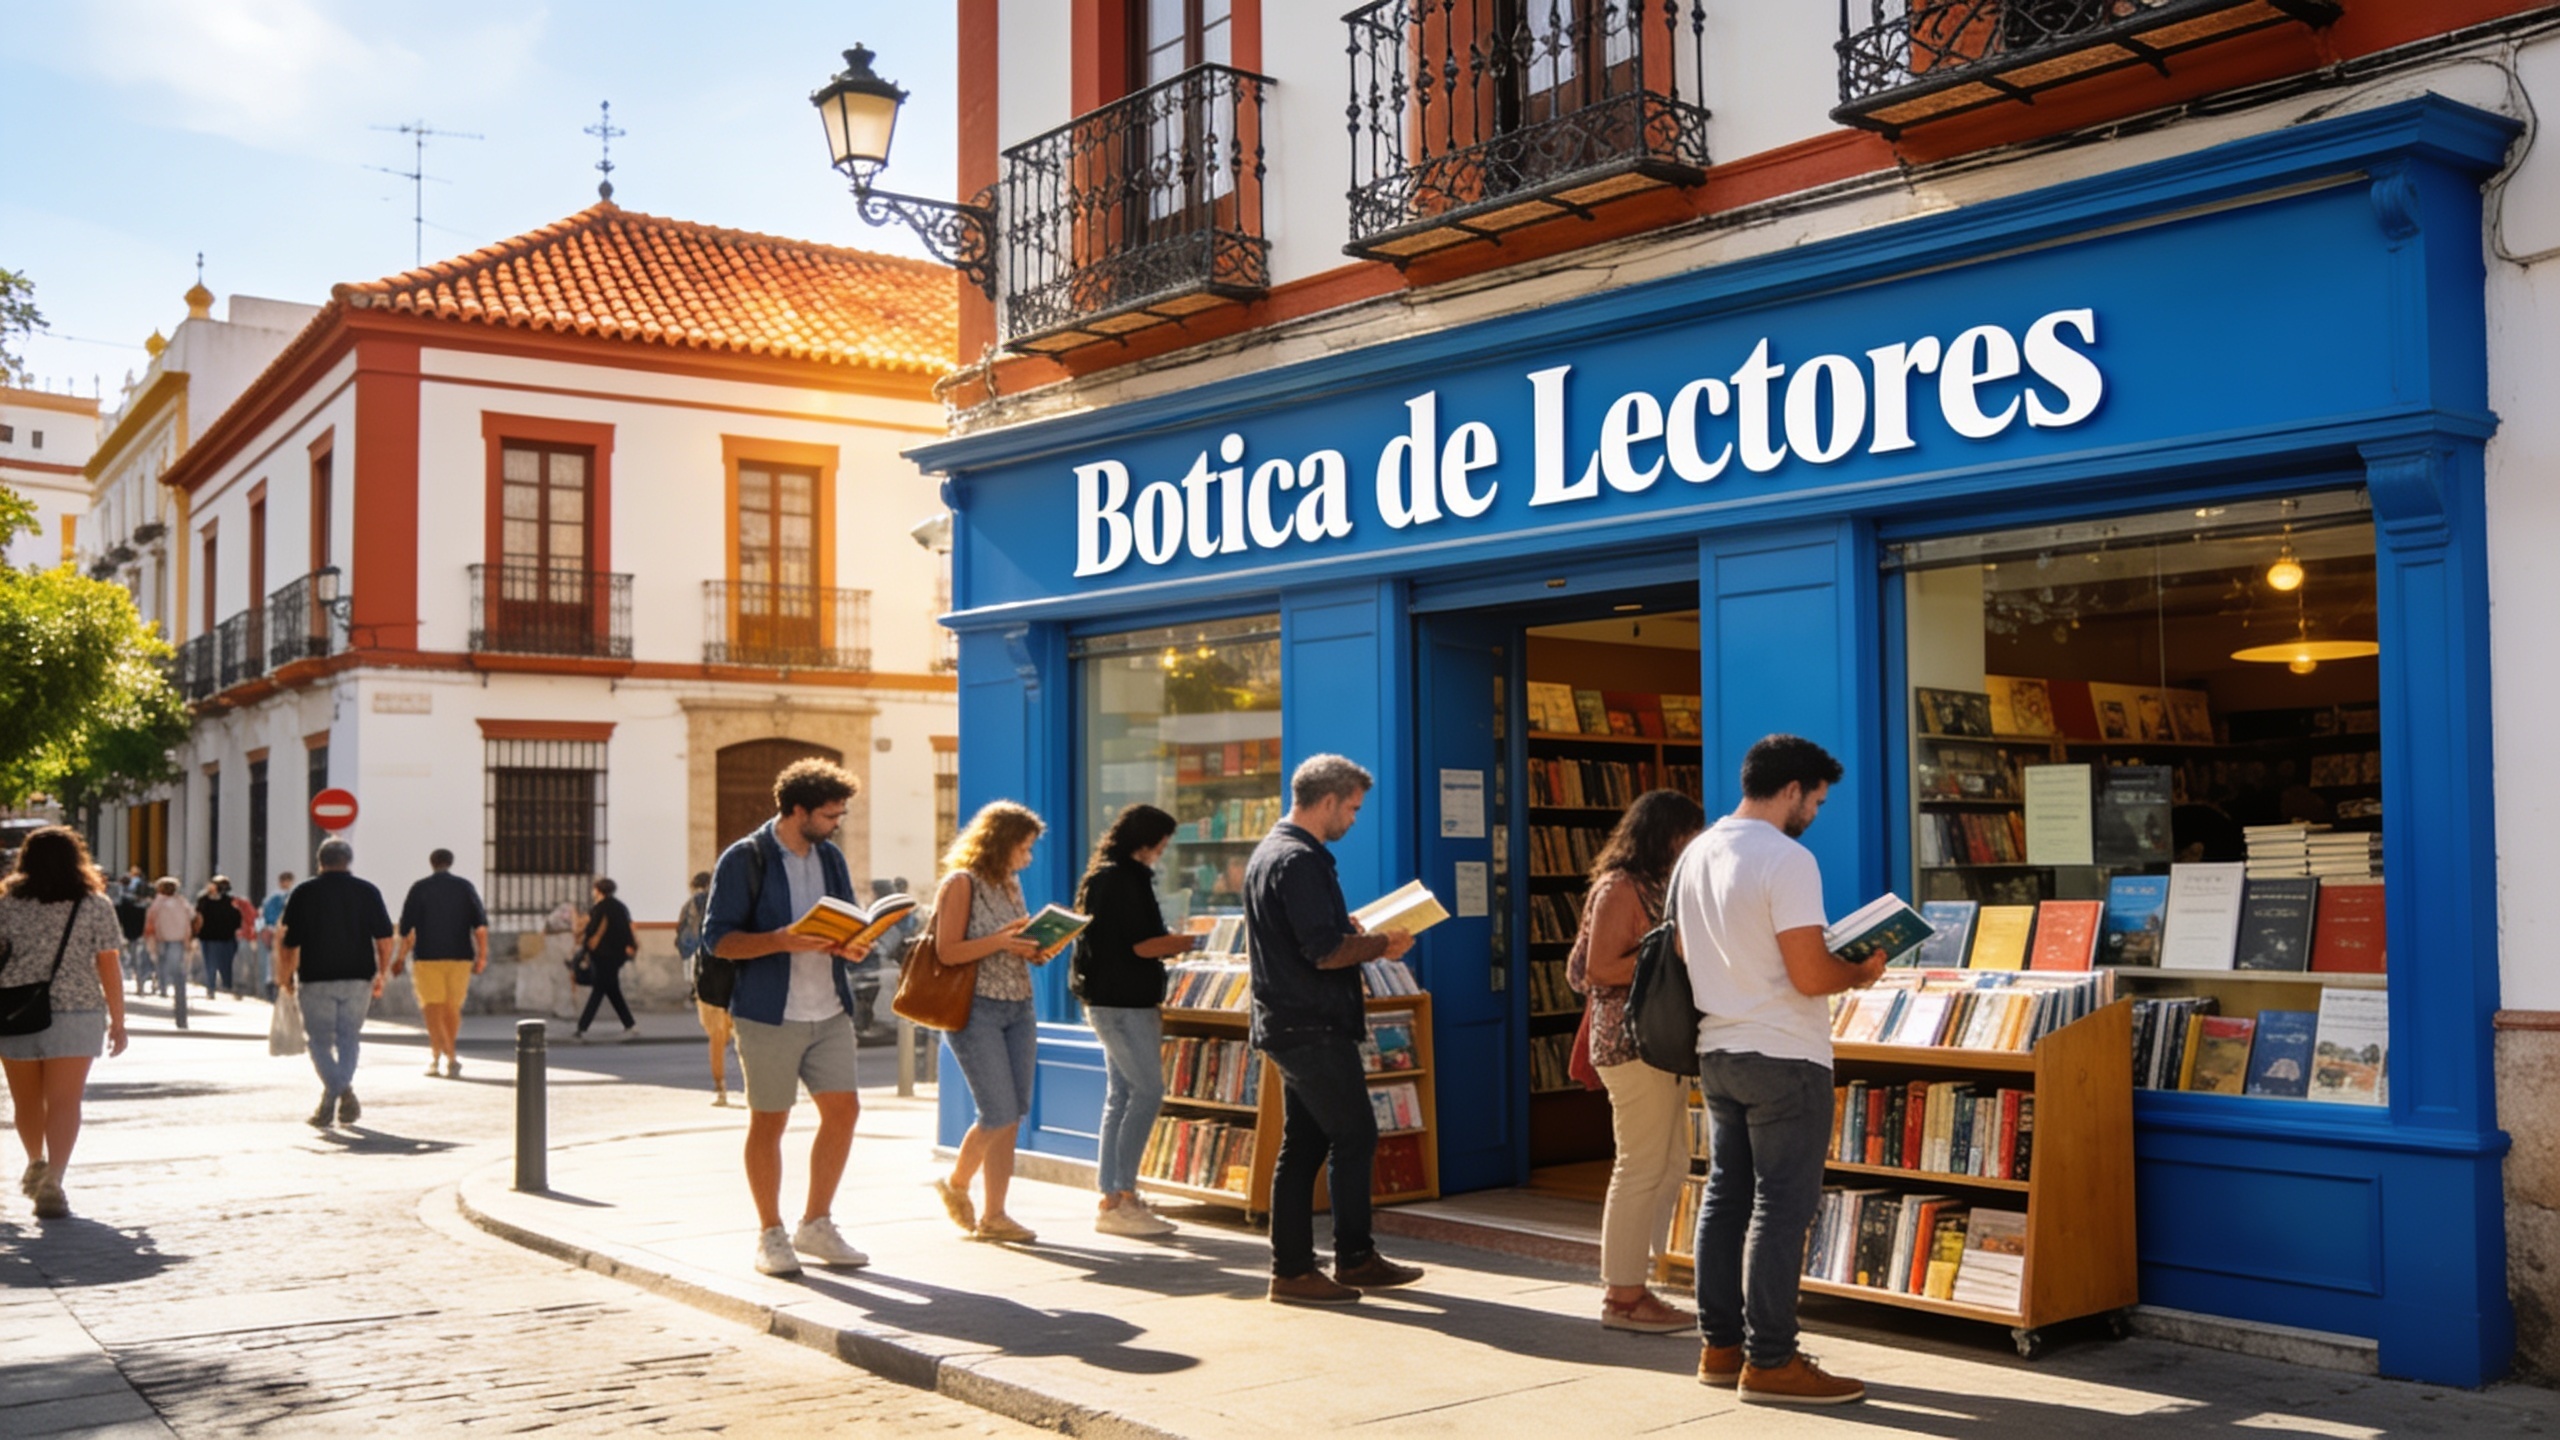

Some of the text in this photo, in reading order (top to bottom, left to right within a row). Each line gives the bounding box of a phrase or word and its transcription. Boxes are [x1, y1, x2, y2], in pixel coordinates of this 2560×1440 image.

[1073, 308, 2103, 578] Botica de Lectores
